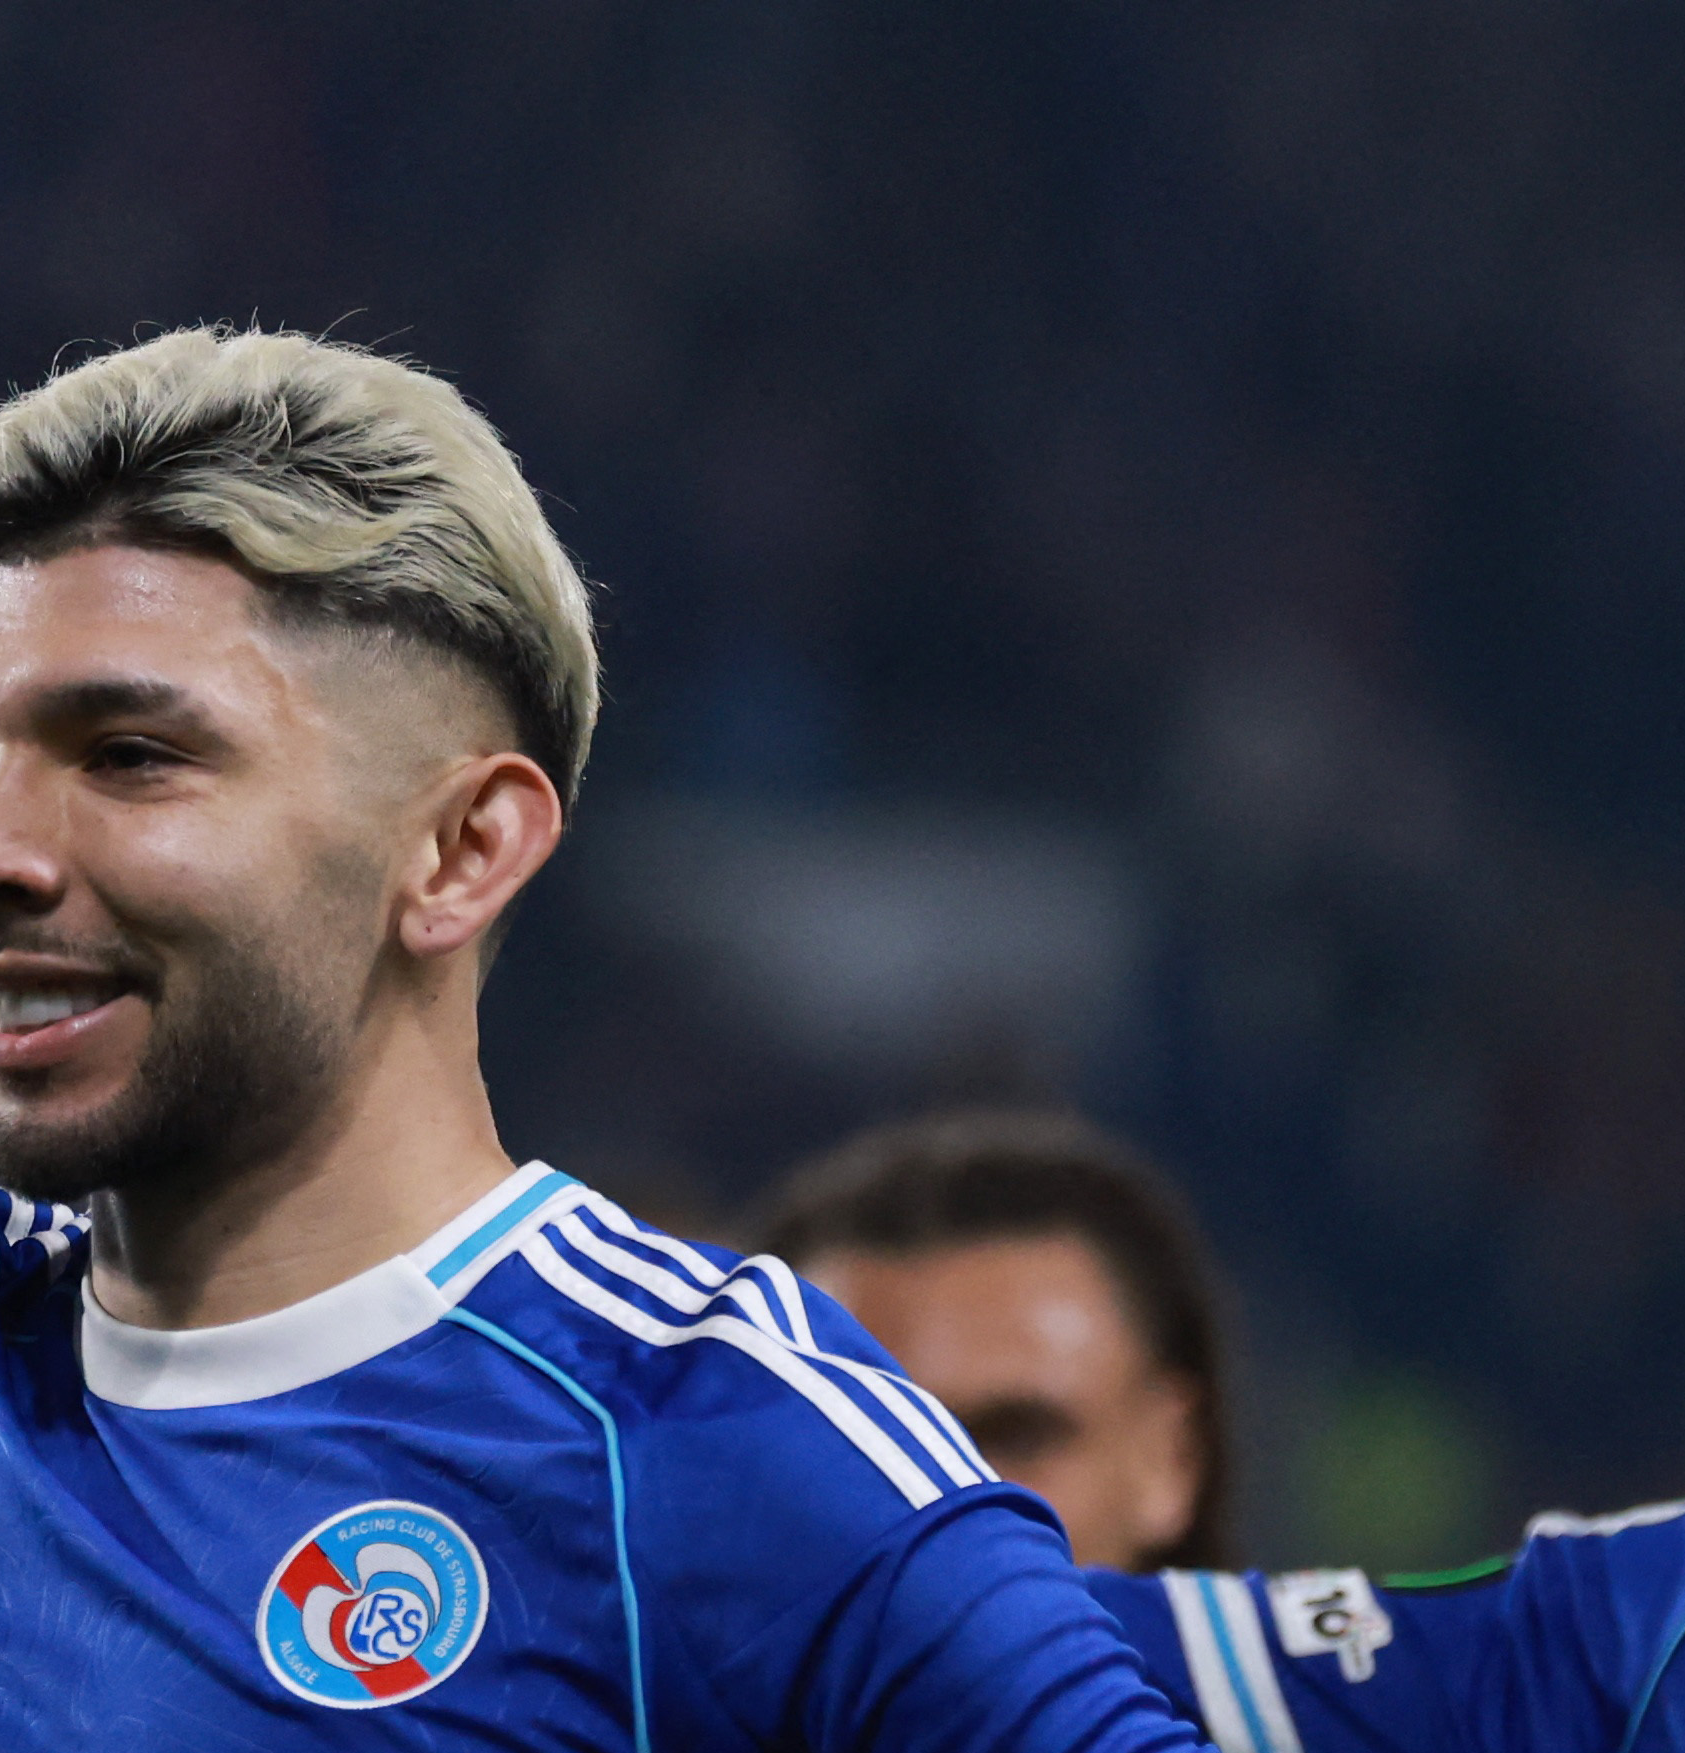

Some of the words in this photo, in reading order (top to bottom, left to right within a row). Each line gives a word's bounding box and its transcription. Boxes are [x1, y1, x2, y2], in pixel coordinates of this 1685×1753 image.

[337, 1518, 396, 1542] RACING
[399, 1520, 437, 1544] CLUB
[434, 1540, 454, 1561] DE
[433, 1559, 467, 1658] STRASBOURG
[279, 1640, 319, 1685] ALSACE
